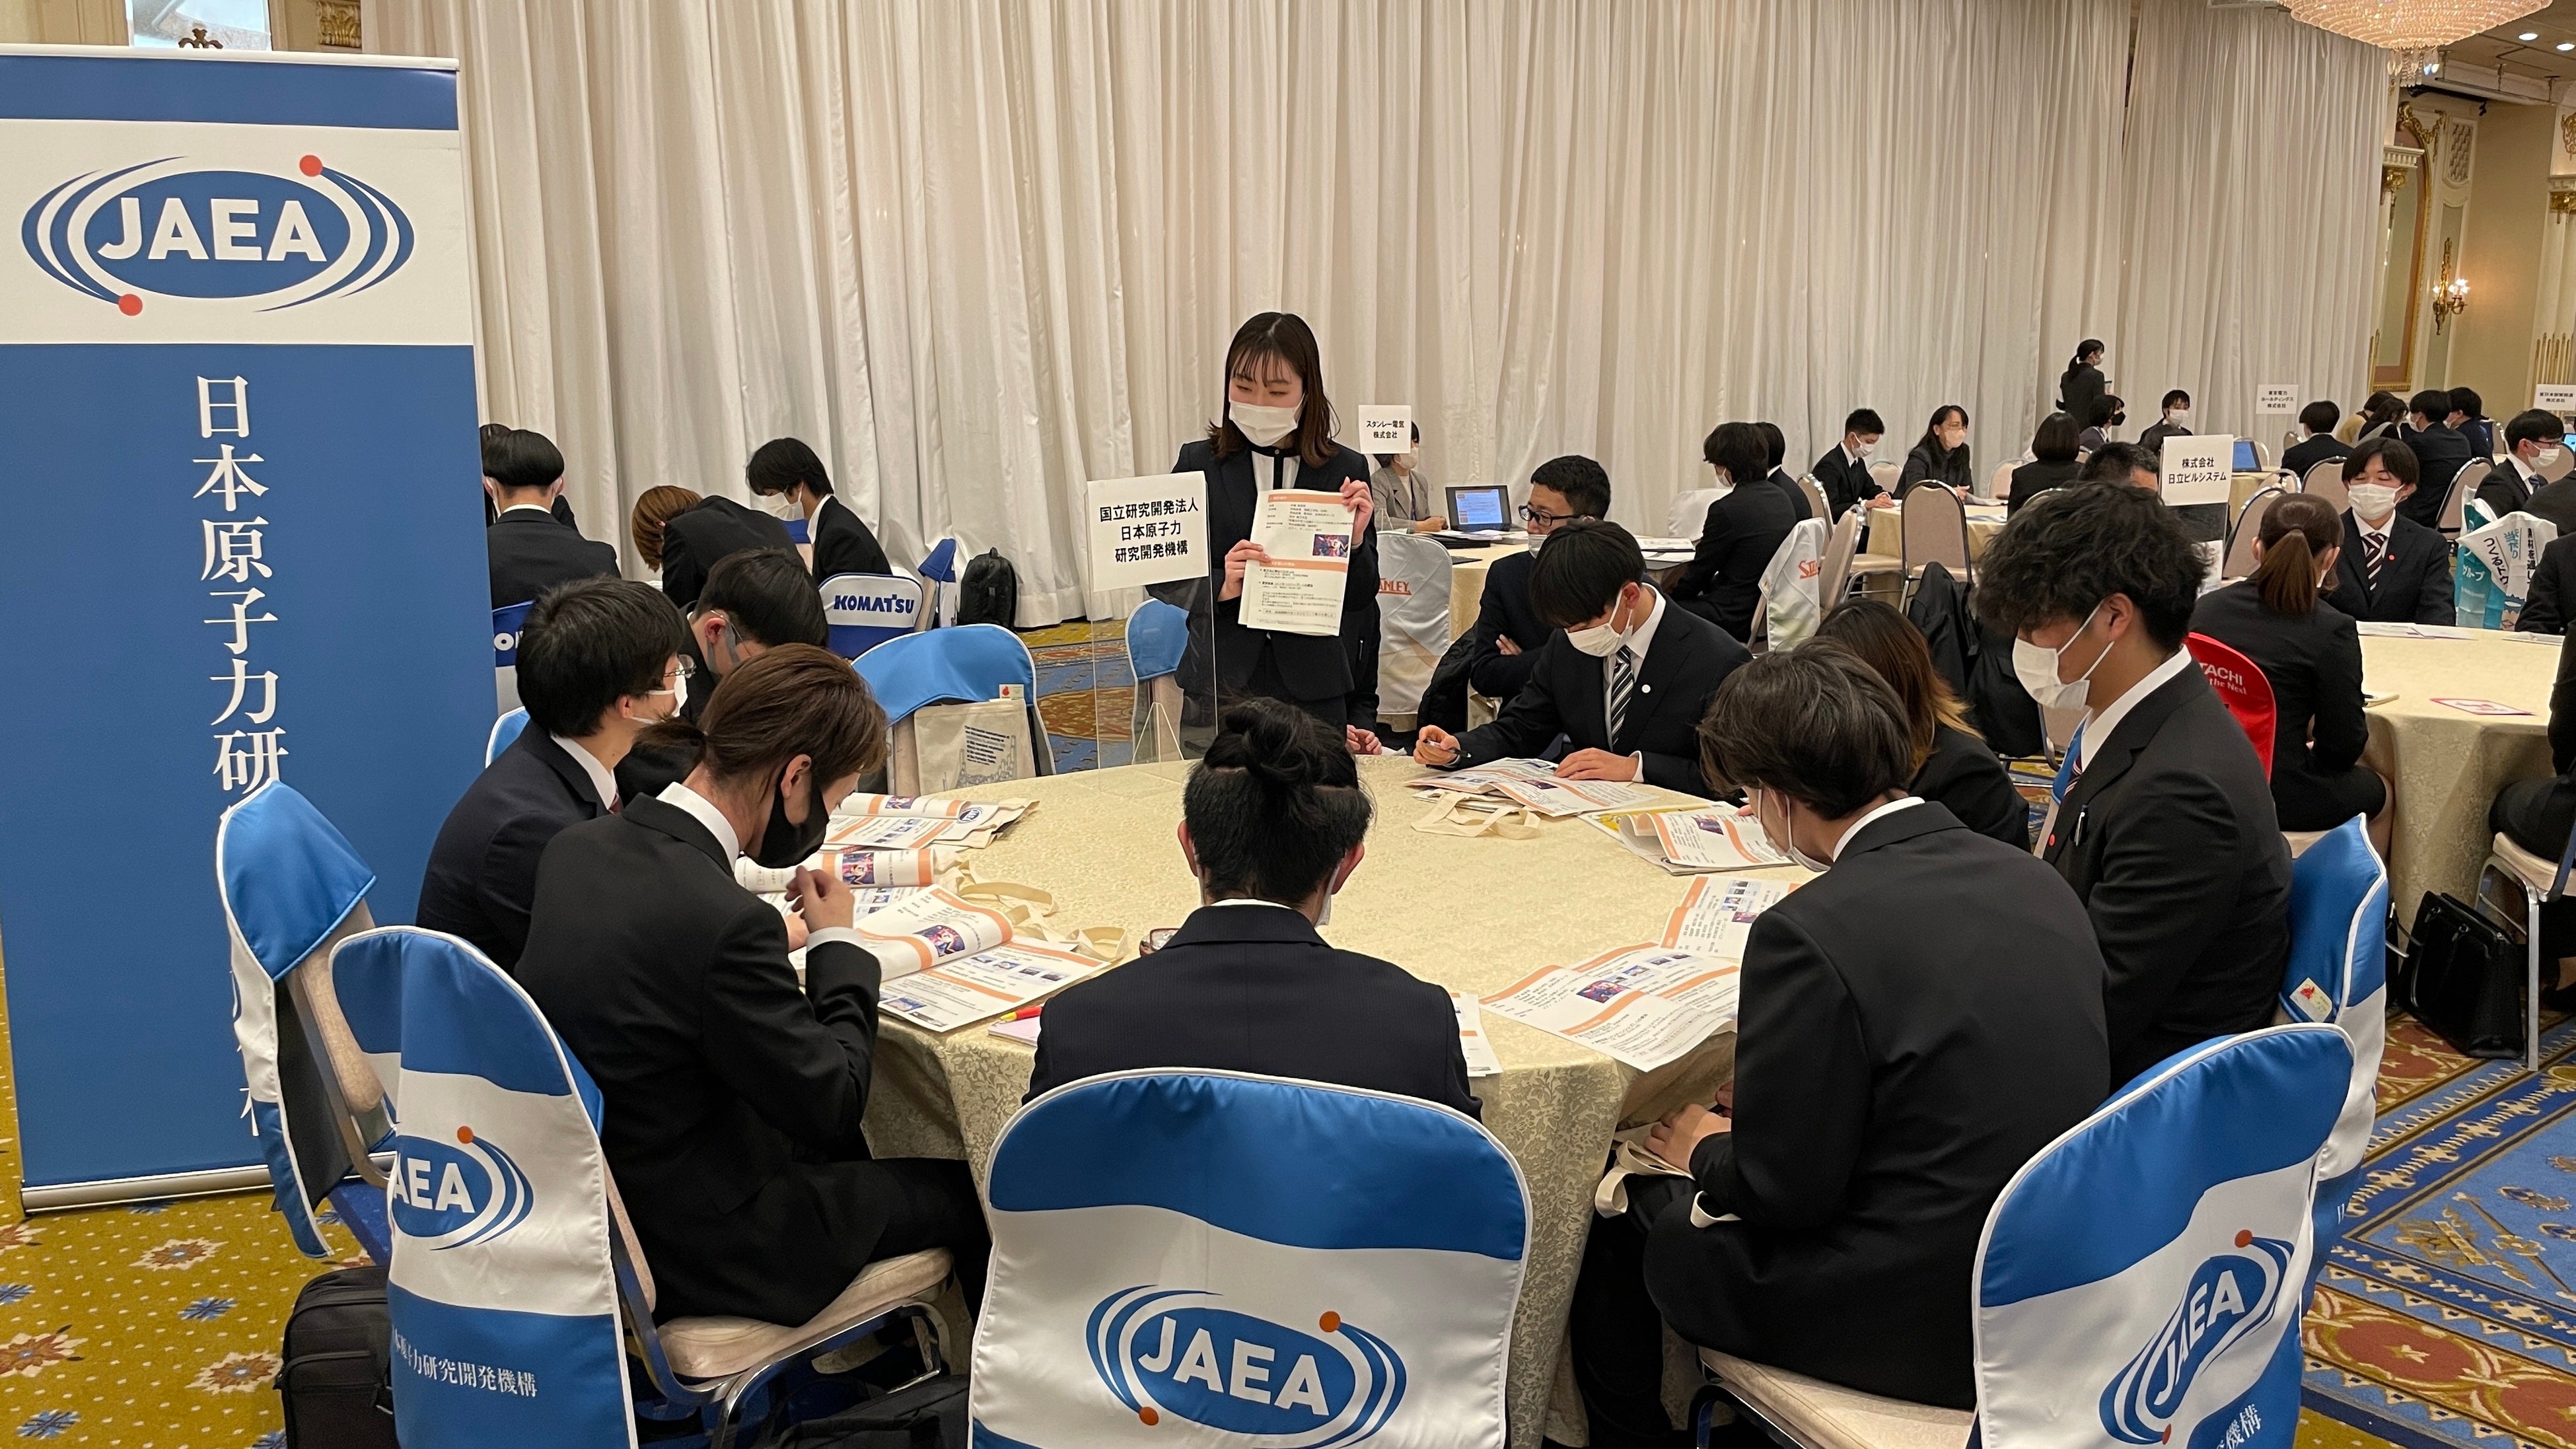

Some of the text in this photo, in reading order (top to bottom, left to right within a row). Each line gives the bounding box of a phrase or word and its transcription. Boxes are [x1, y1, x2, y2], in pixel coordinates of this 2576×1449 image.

[98, 197, 328, 262] JAEA
[2182, 456, 2215, 469] 株式会社
[2168, 472, 2227, 484] 日立ビルシステム
[1100, 497, 1199, 522] 国立研究開発法人
[1121, 520, 1181, 542] 日本原子力
[1115, 540, 1188, 563] 研究開発機構
[1380, 578, 1410, 592] NLEY
[834, 594, 915, 614] KOMATSU
[2199, 662, 2243, 686] TACHI
[2209, 678, 2225, 688] the
[193, 375, 289, 1137] 日本原子力研
[393, 1152, 476, 1213] AEA
[2153, 1269, 2246, 1406] JAEA
[1138, 1316, 1330, 1417] JAEA
